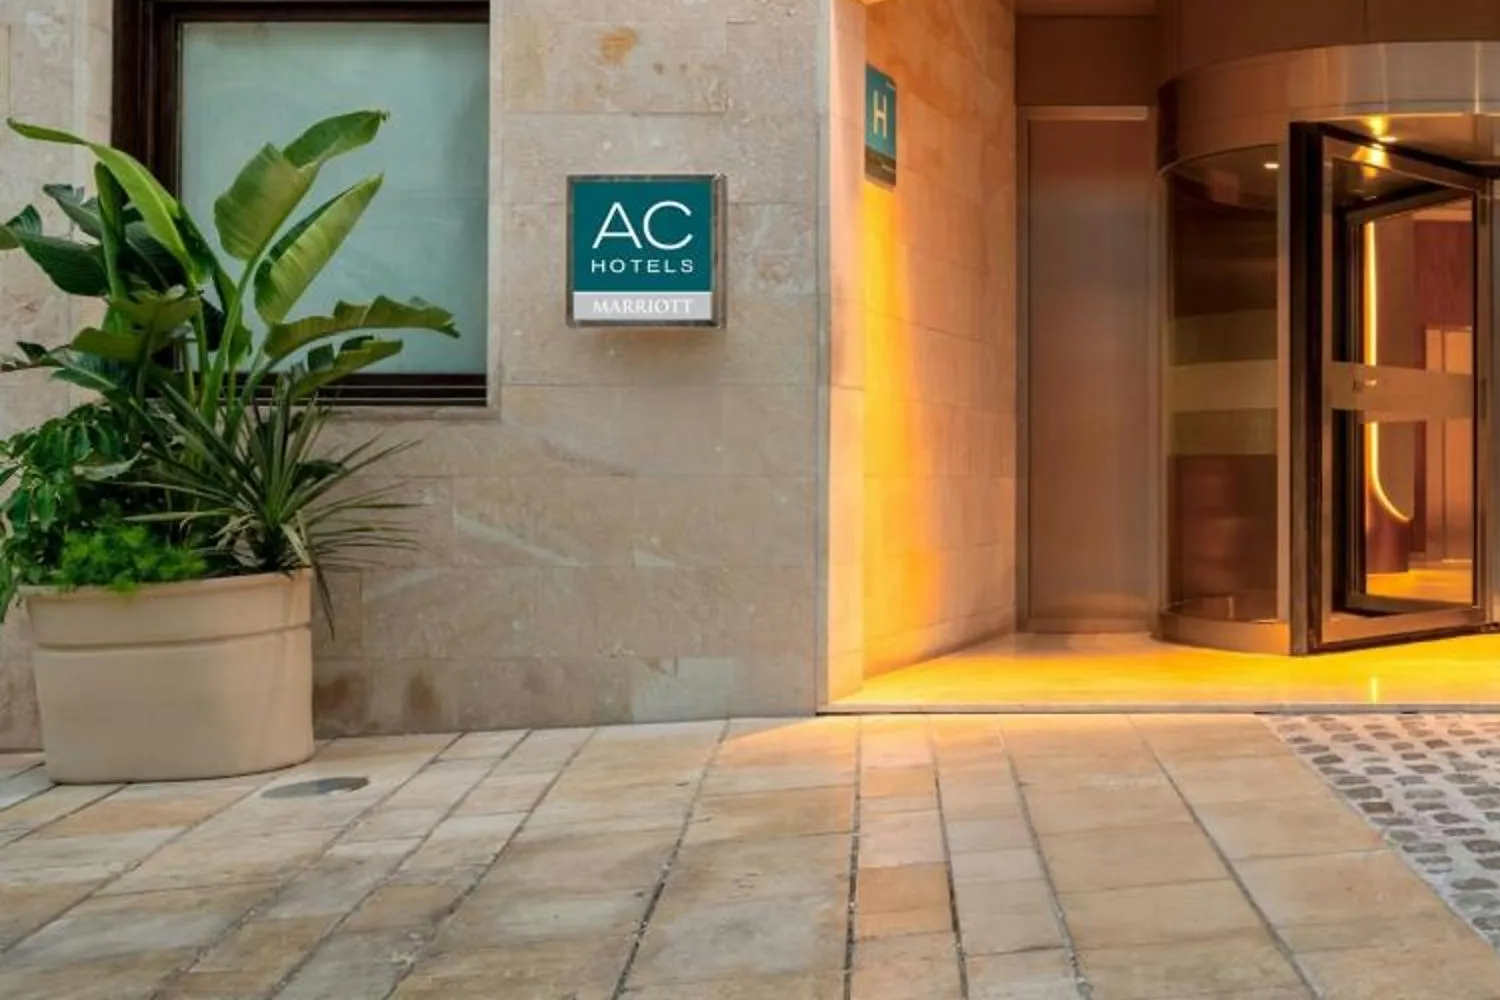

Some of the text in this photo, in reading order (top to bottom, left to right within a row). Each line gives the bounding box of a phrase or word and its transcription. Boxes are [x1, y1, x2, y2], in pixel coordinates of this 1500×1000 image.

[873, 89, 887, 139] H
[592, 200, 693, 250] AC
[591, 259, 694, 273] HOTELS
[592, 299, 694, 314] MARRIOTT
